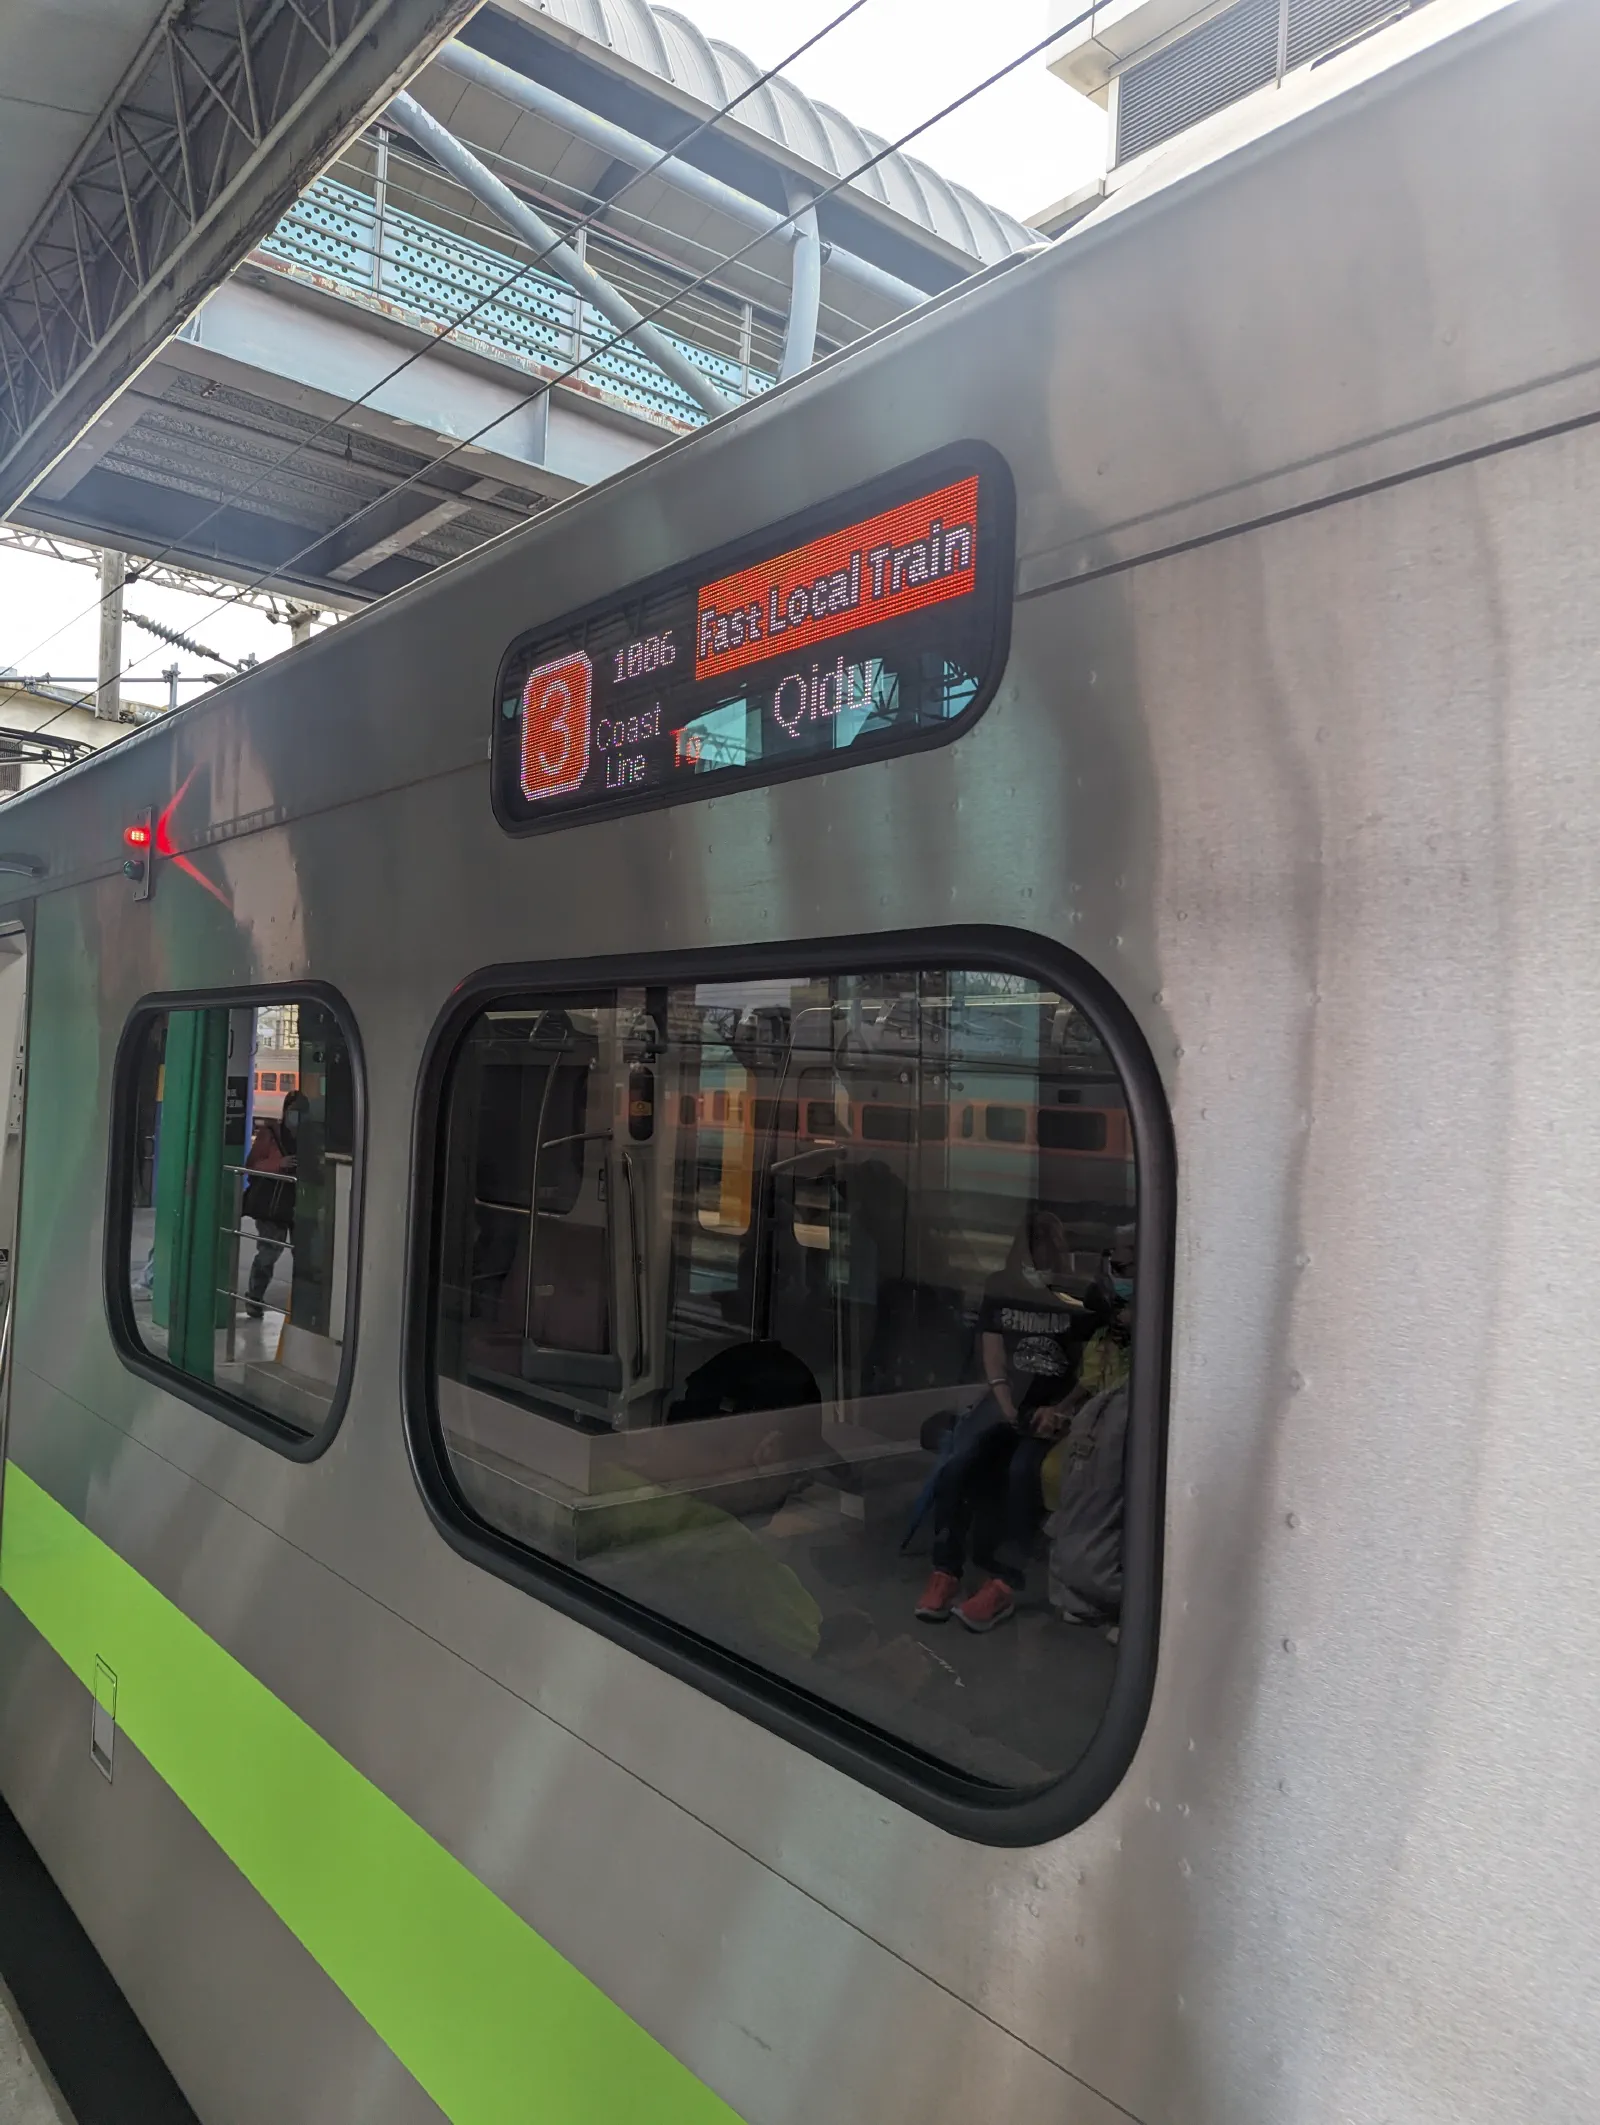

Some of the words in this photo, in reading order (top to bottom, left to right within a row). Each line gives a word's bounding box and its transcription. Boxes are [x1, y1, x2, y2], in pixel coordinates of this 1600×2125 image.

[699, 603, 762, 657] Fast
[768, 552, 861, 633] Local
[868, 522, 972, 598] Train
[612, 629, 677, 684] 1006
[537, 678, 572, 777] 3
[596, 700, 662, 752] Coast
[668, 726, 701, 768] To
[773, 655, 873, 739] Qidu
[605, 751, 647, 789] Line
